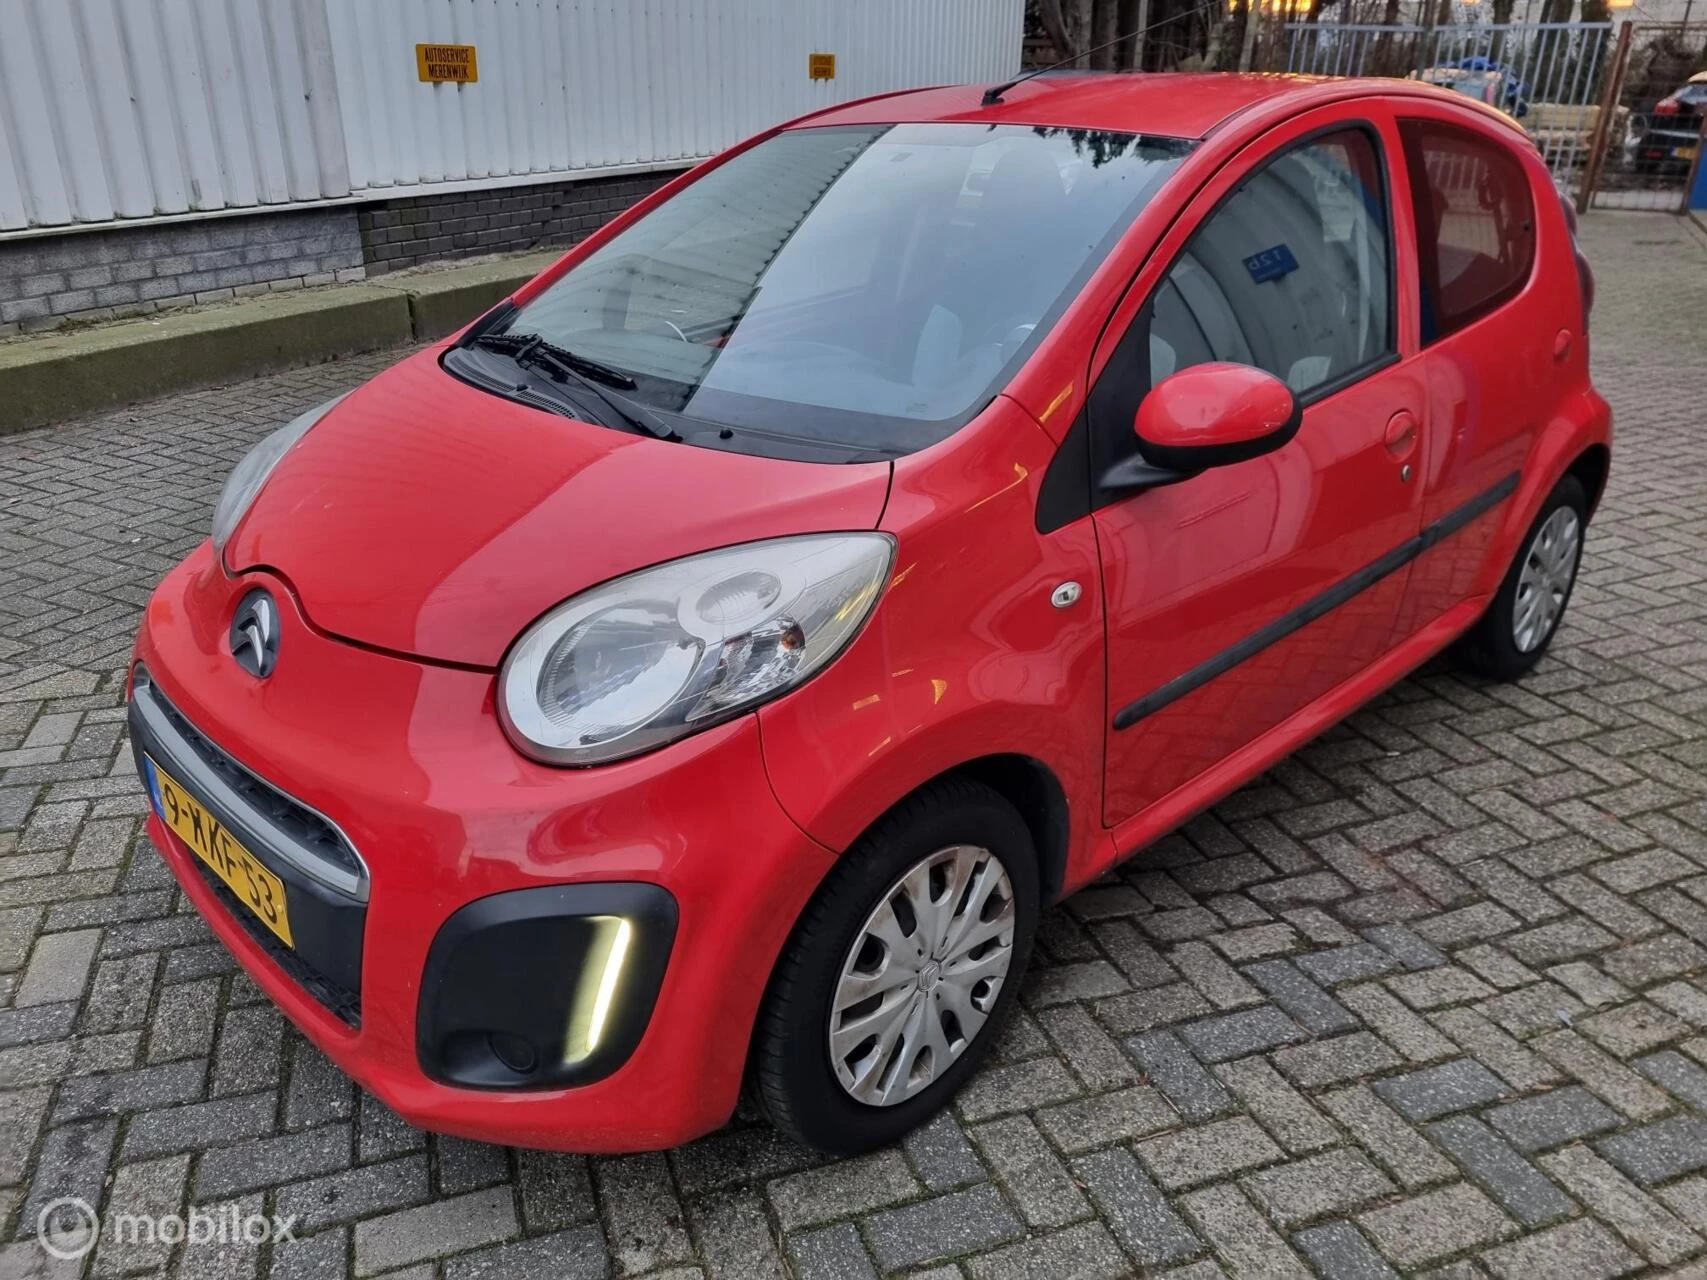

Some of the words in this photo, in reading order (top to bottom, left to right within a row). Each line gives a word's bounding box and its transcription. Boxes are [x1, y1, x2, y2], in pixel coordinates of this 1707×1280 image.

[424, 47, 469, 63] AUTOSERVICE
[428, 63, 469, 79] MERENWIJK
[163, 782, 278, 925] 9-XKF-53
